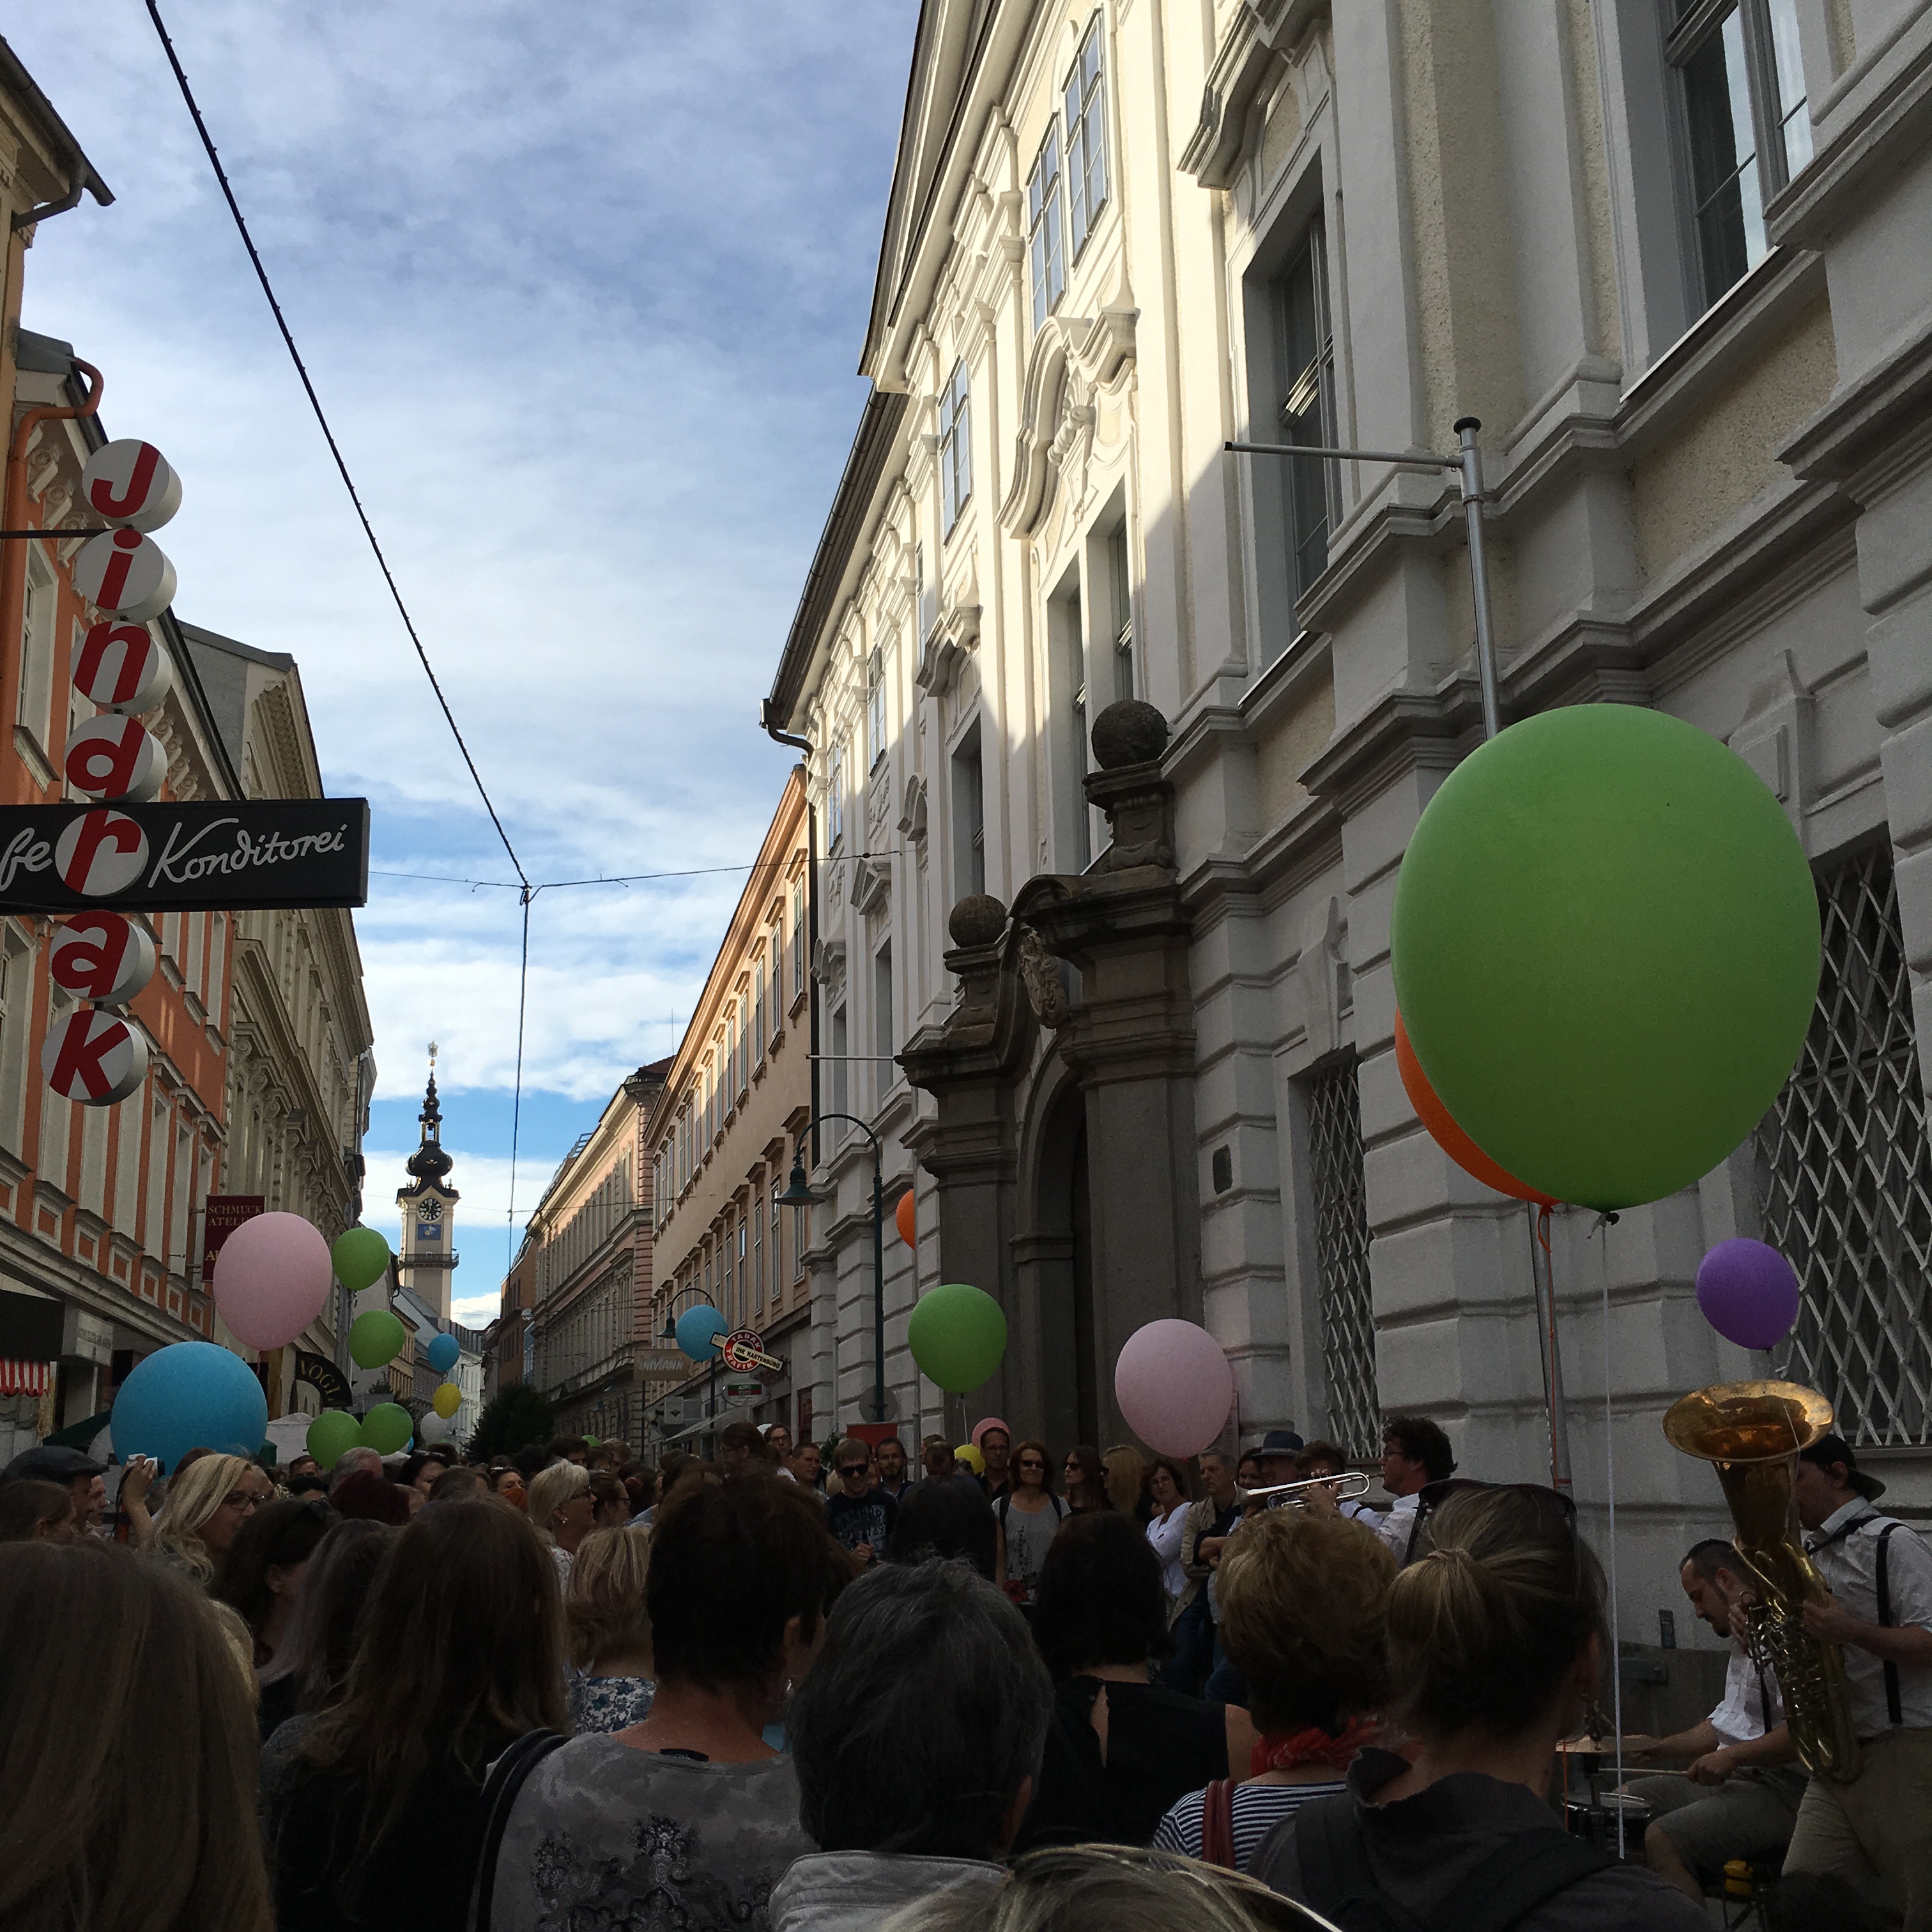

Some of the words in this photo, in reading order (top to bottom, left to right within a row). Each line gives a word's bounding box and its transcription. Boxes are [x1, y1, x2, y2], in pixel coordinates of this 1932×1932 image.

[148, 818, 348, 888] Konditorei
[208, 1206, 262, 1214] SCHMUCK
[208, 1217, 250, 1226] ATELI
[732, 1333, 761, 1347] TABAK
[726, 1348, 753, 1370] TRAFIK
[300, 1360, 341, 1401] VOGL
